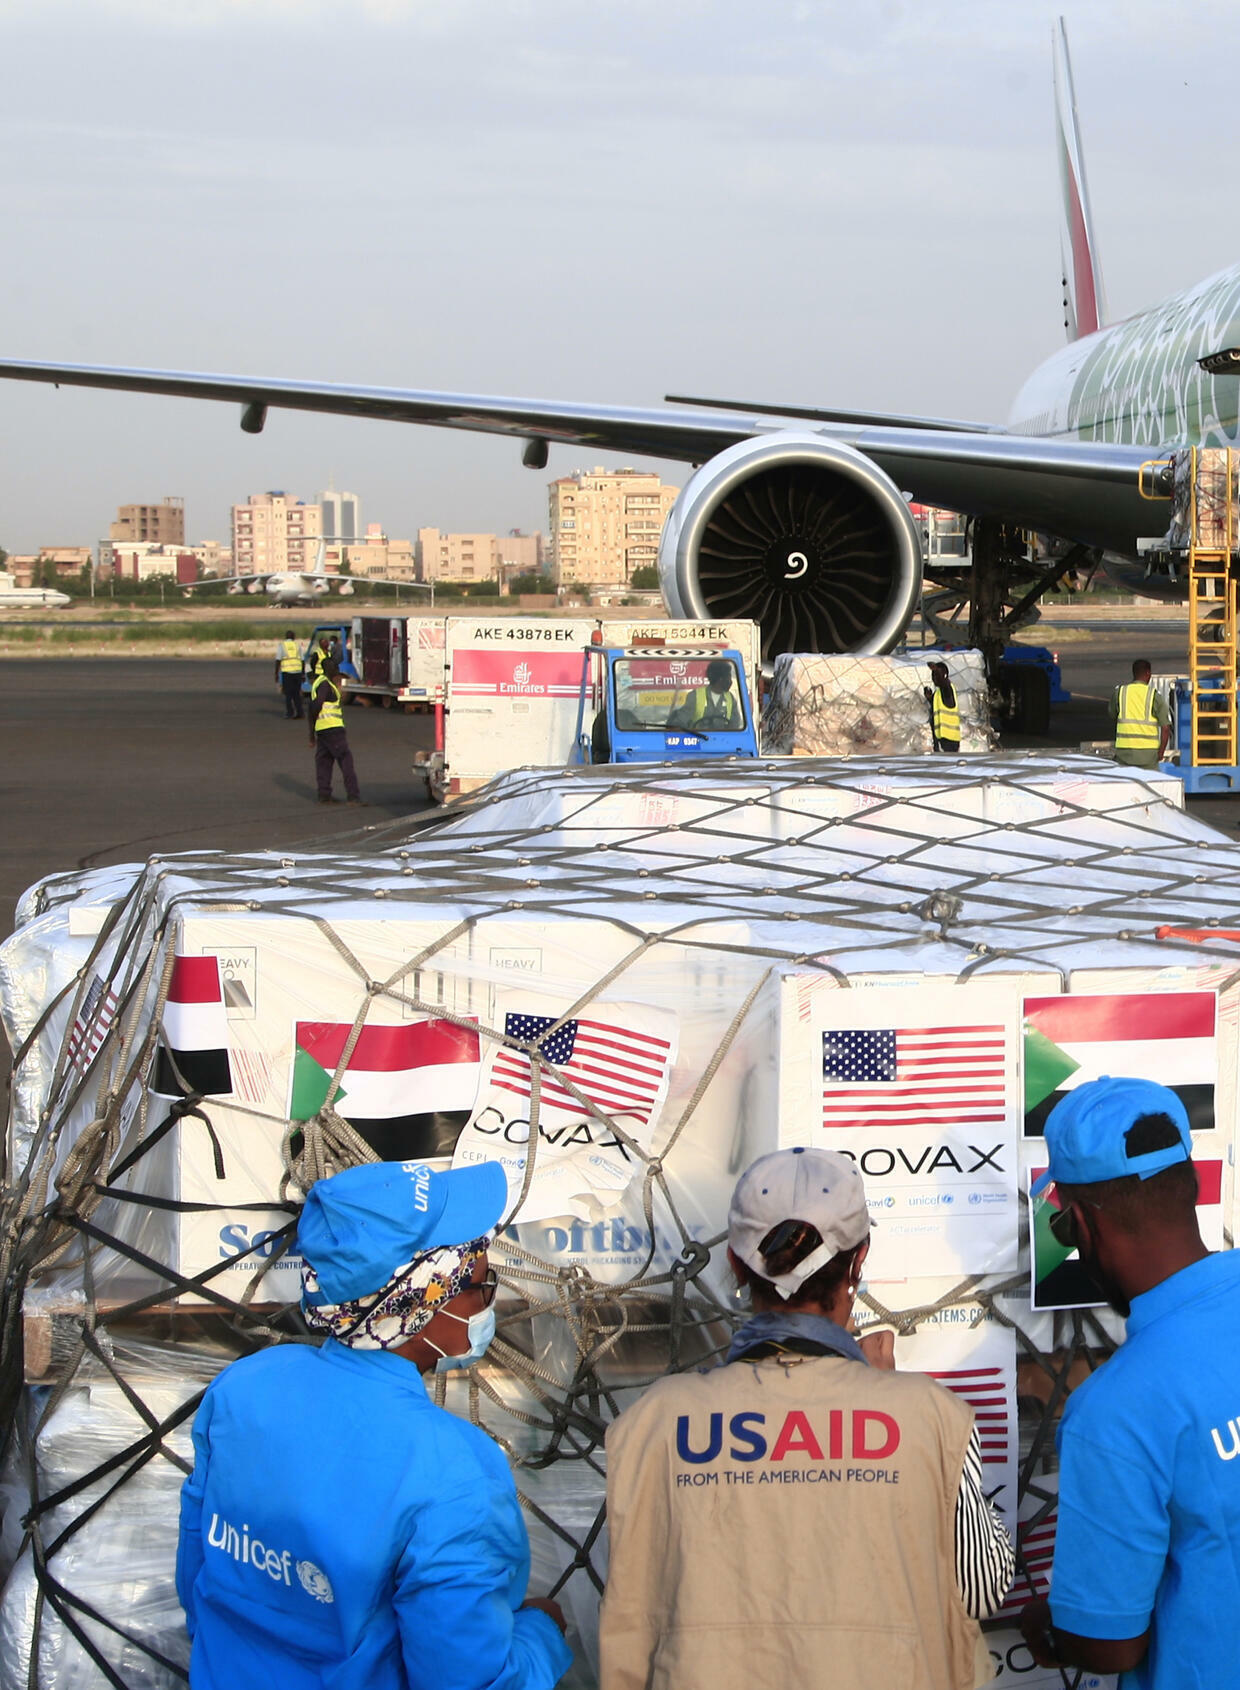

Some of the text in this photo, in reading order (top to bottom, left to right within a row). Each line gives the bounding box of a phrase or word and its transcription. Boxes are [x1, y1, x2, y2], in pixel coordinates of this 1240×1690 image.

[474, 628, 574, 641] AKE 43878 EK
[709, 628, 728, 639] EK
[655, 675, 703, 685] Emiates
[500, 683, 545, 694] Emirates
[219, 958, 250, 969] EAVY
[495, 959, 536, 969] HEAVY
[473, 1106, 639, 1163] COVAX
[274, 1261, 303, 1270] CONTRO
[676, 1410, 900, 1464] USAID
[676, 1468, 899, 1488] FROM THE AMERICAN PEOPLE
[208, 1512, 291, 1586] unicef
